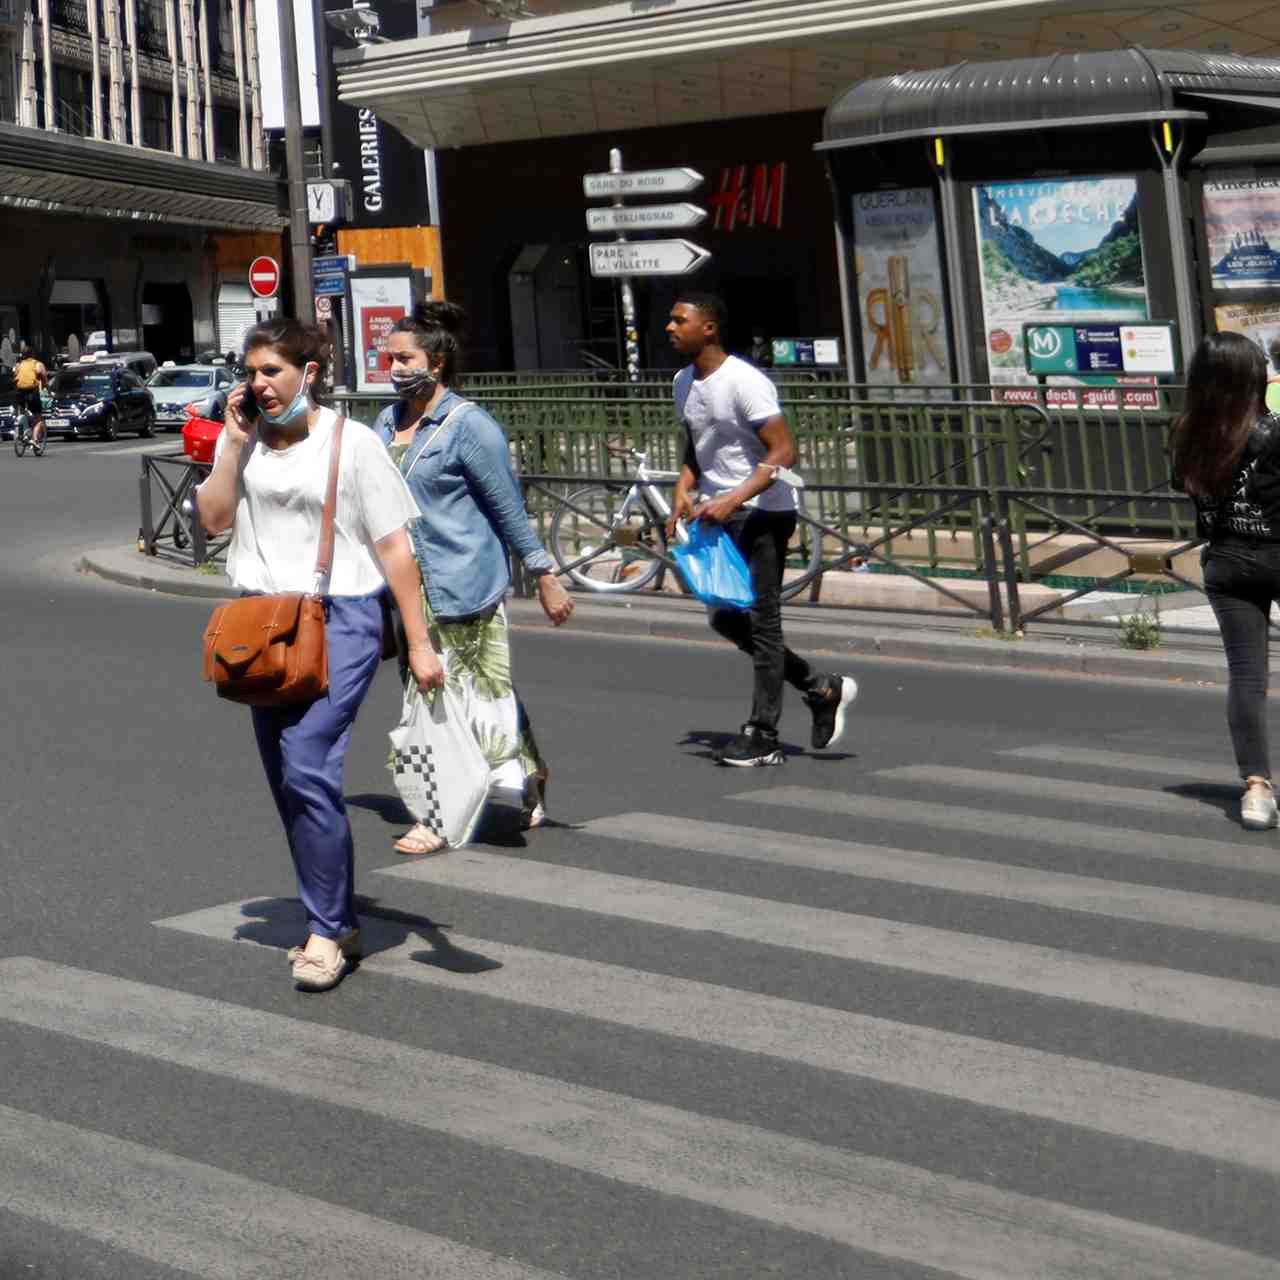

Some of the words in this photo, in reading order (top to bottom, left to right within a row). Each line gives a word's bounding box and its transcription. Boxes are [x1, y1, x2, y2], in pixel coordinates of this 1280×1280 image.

[358, 108, 383, 212] GALERIES
[707, 162, 785, 232] H&M
[596, 248, 624, 258] PARC
[613, 258, 661, 270] VILLETTE
